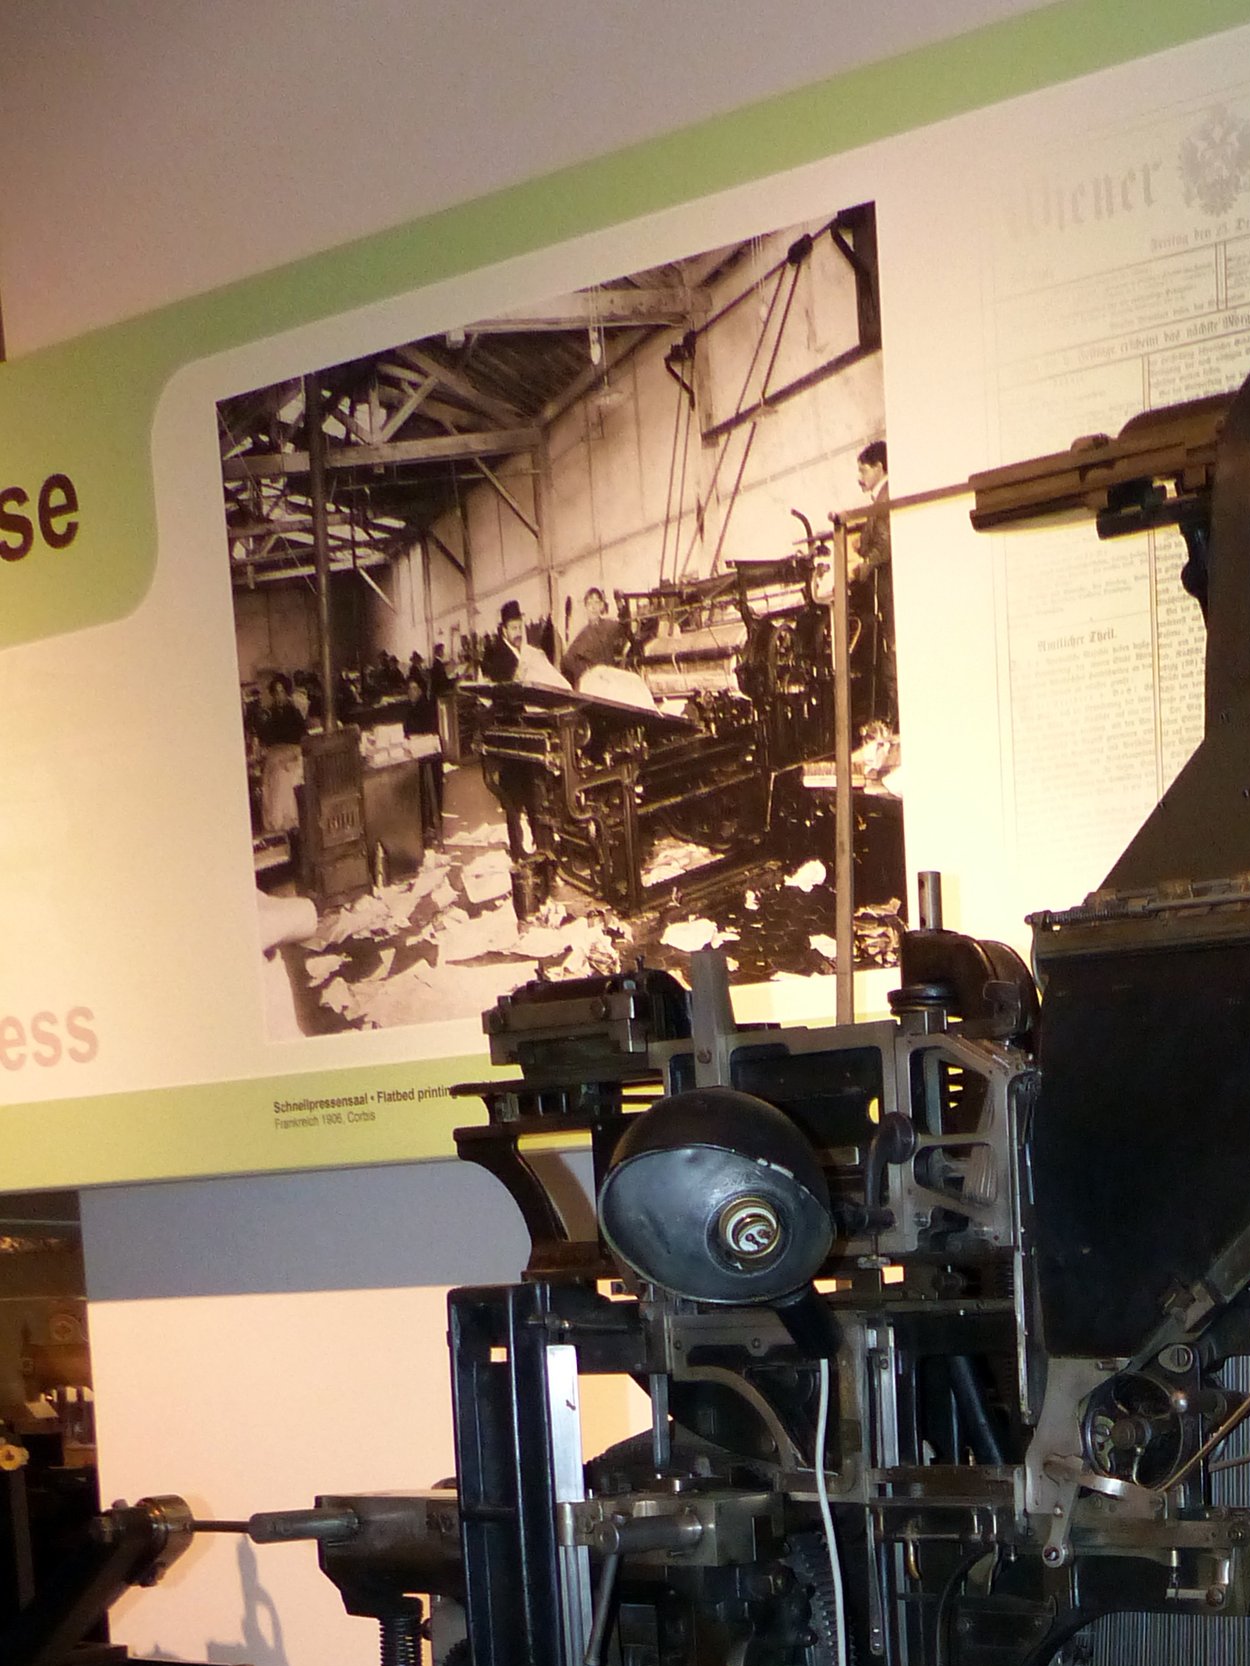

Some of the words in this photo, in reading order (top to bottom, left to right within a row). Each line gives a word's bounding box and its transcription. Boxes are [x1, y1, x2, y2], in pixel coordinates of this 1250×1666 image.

[0, 473, 79, 561] se
[0, 1006, 98, 1071] ess
[273, 1092, 369, 1114] Schnellpressensaal
[376, 1088, 415, 1104] Flatbed
[274, 1115, 320, 1130] Frankreich
